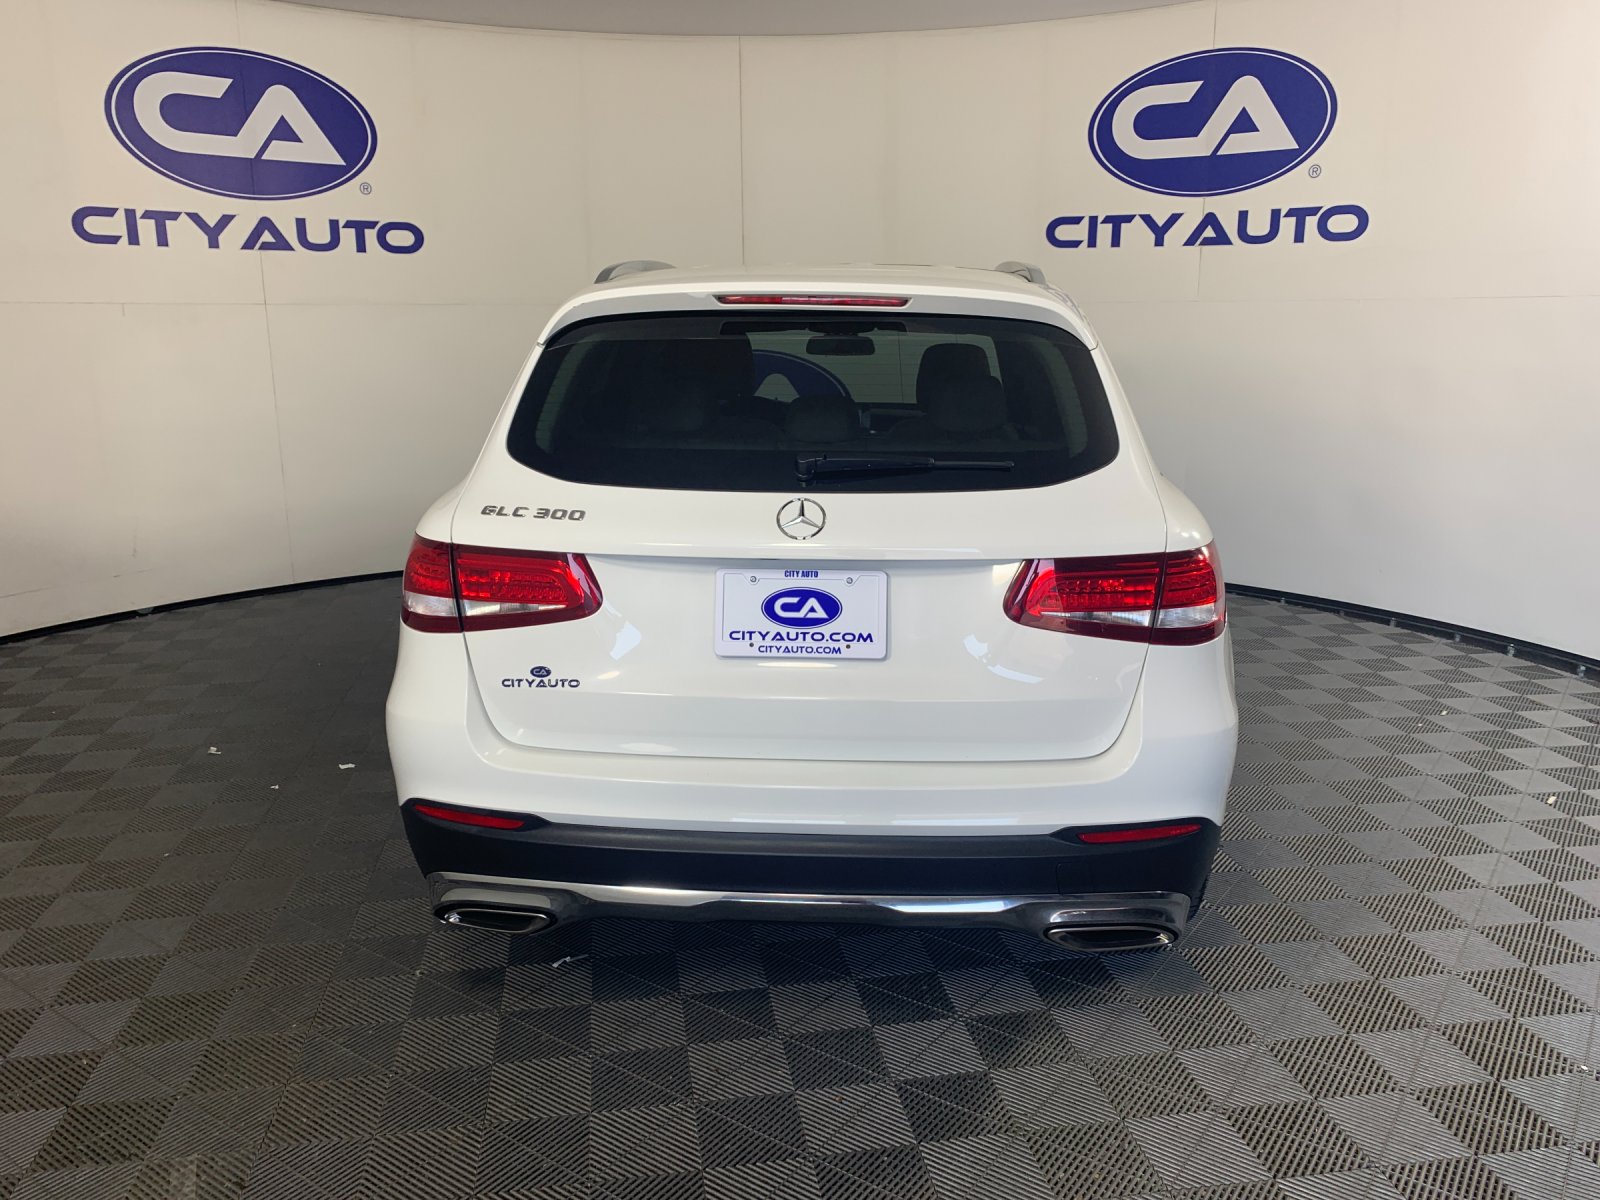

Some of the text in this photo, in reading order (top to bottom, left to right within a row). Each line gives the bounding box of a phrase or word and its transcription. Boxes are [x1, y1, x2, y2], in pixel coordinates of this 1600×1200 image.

[133, 71, 347, 166] CA
[1111, 74, 1300, 160] CA
[480, 505, 586, 521] GLC 300
[784, 570, 818, 578] CITY AUTO
[774, 597, 829, 618] CA
